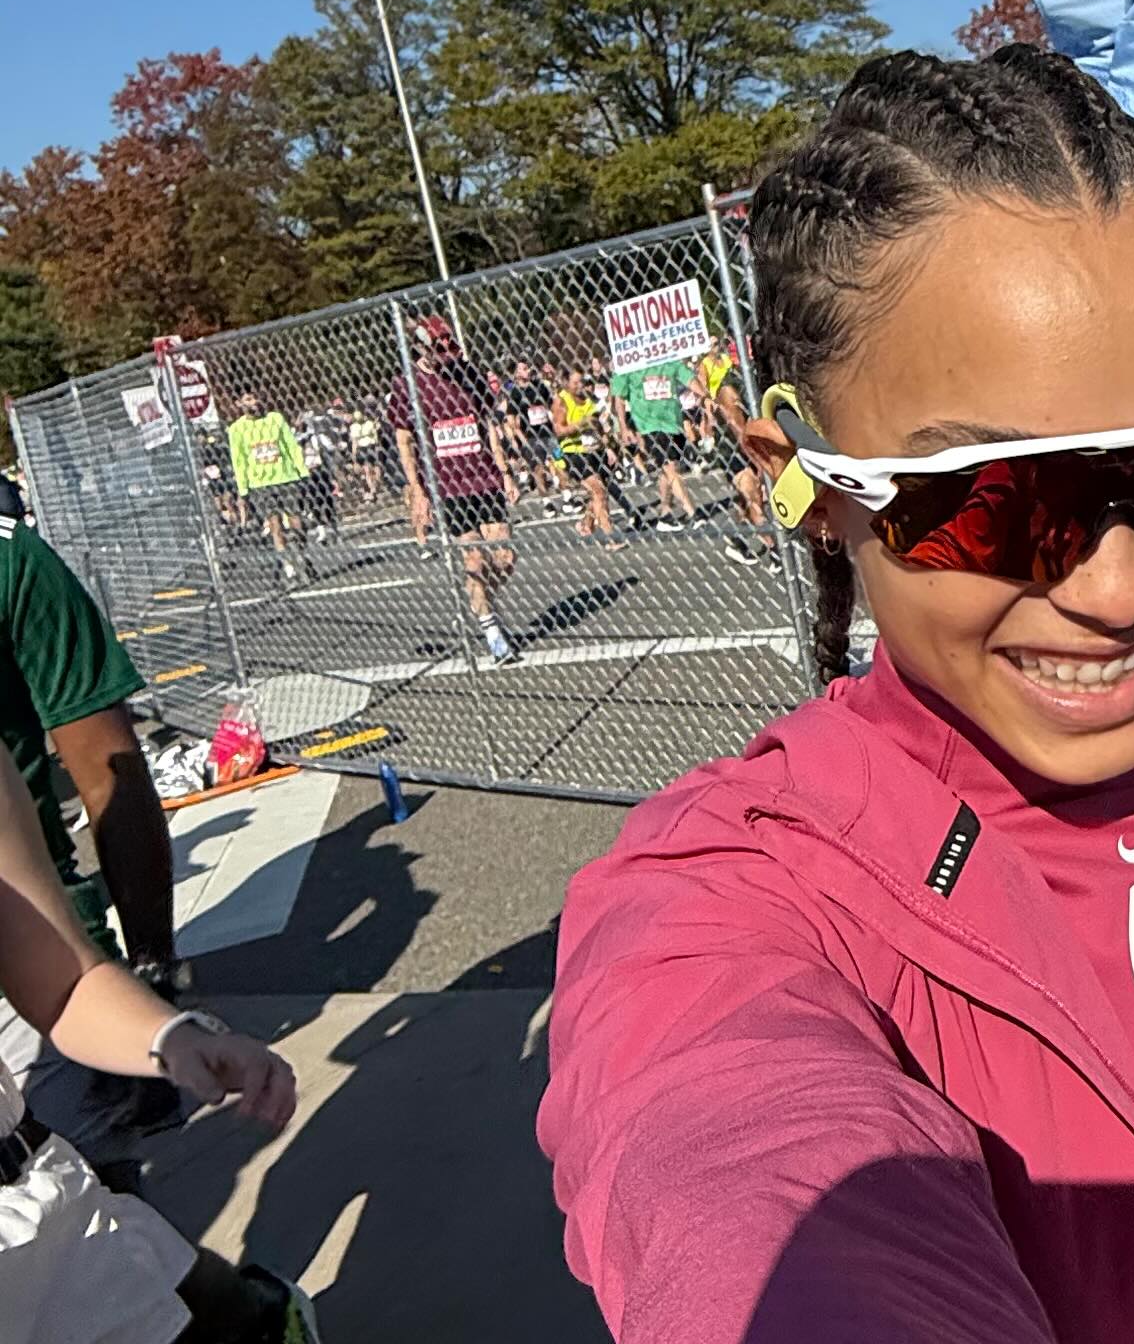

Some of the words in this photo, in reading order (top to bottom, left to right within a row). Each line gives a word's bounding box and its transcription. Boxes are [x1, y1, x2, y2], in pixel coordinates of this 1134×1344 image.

[608, 286, 699, 342] NATIONAL
[614, 319, 702, 353] RENT-A-FENCE
[616, 332, 706, 366] 800-352-5675
